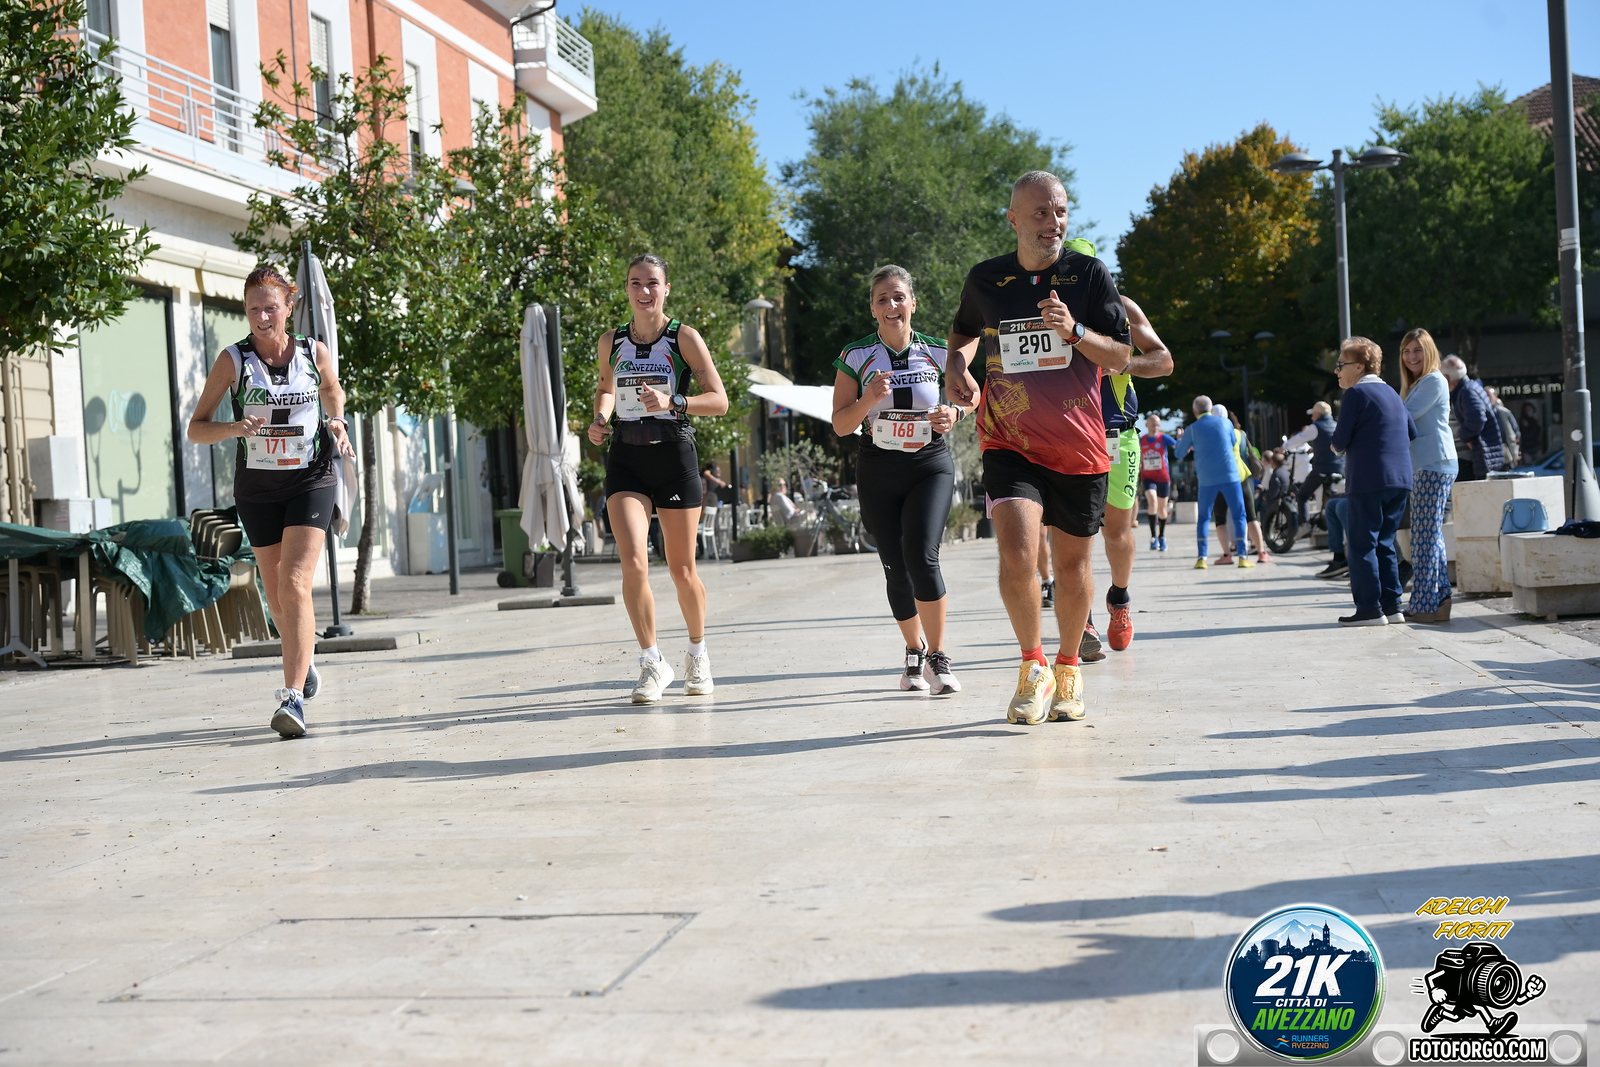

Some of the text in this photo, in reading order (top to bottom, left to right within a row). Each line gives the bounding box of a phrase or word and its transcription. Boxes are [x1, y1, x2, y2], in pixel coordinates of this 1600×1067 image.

[1010, 322, 1027, 332] 21K
[1019, 333, 1052, 355] 290
[629, 361, 671, 375] AVEZZANO
[624, 378, 637, 386] 21K
[1062, 398, 1088, 410] SPQR
[887, 412, 901, 420] 10K
[892, 423, 915, 438] 168
[265, 438, 287, 454] 171
[1128, 451, 1136, 483] asics
